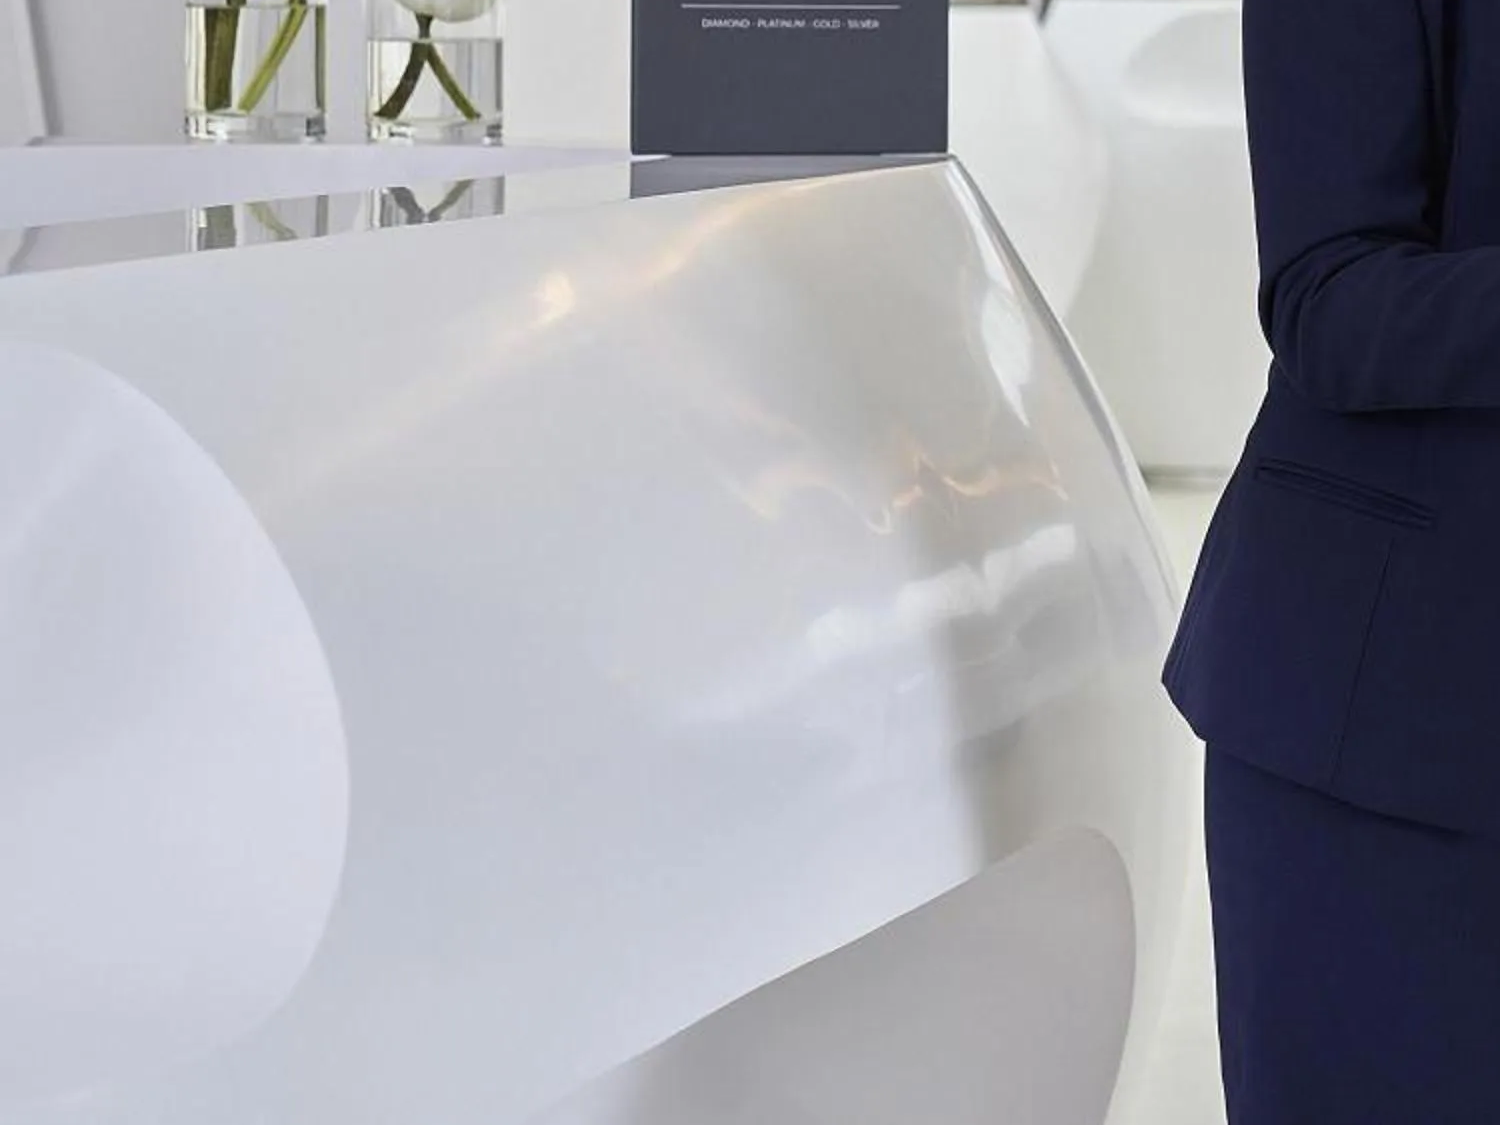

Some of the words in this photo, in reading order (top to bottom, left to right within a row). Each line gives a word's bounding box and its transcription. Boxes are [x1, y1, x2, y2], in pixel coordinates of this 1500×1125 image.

[701, 18, 750, 29] DIAMOND
[757, 18, 806, 29] PLATINUM
[813, 19, 841, 29] GOLD
